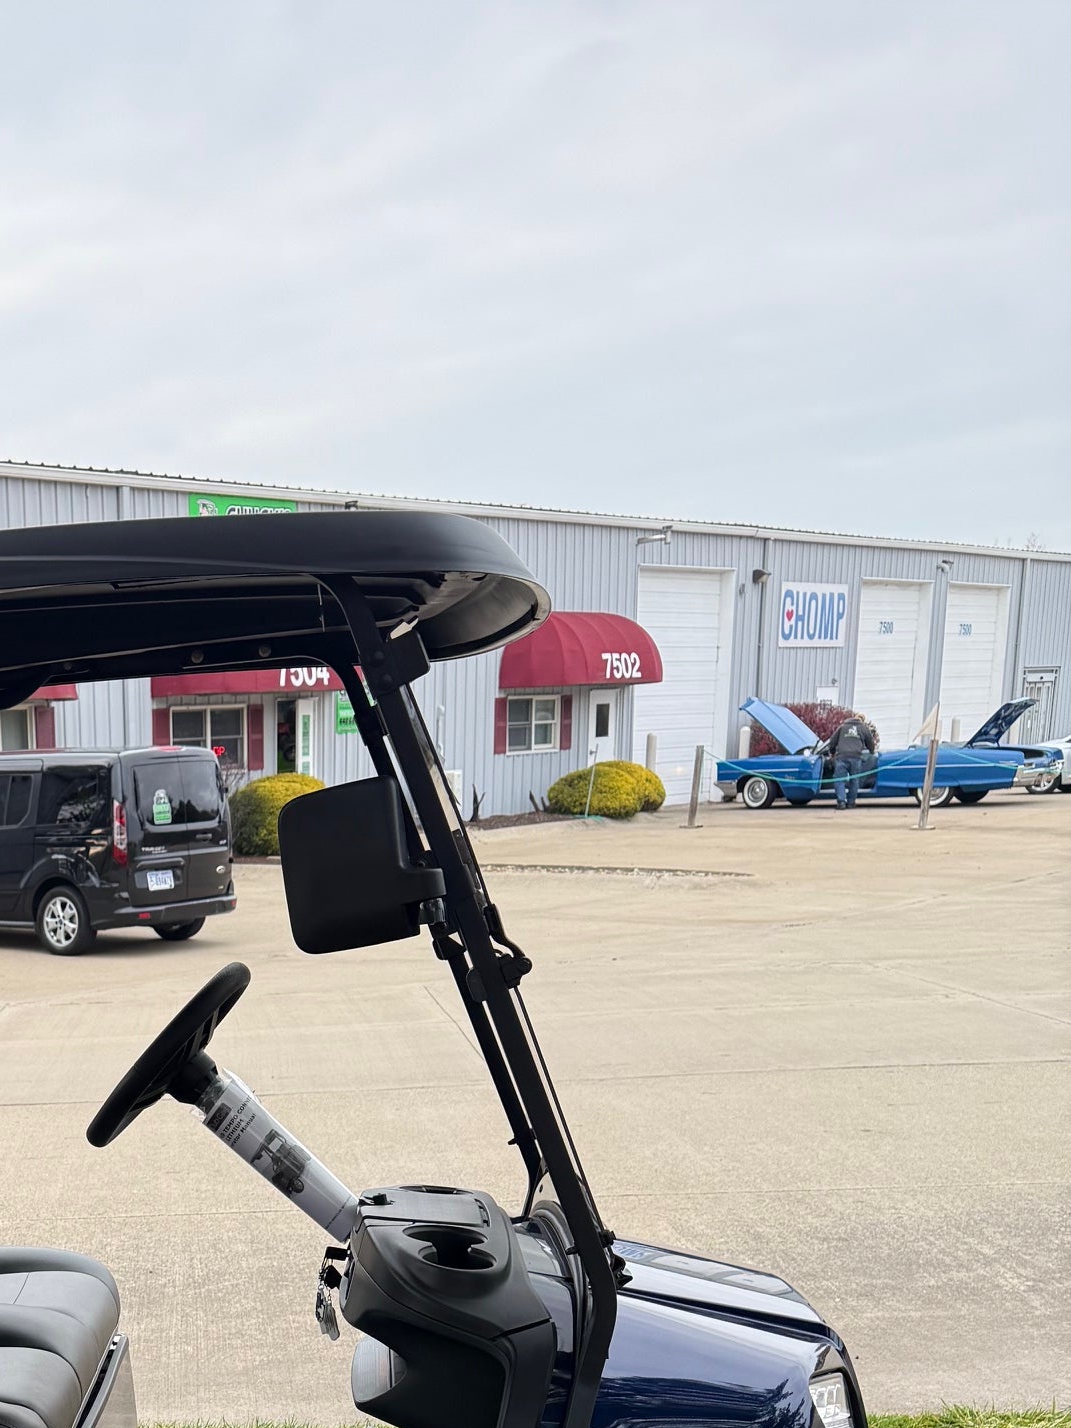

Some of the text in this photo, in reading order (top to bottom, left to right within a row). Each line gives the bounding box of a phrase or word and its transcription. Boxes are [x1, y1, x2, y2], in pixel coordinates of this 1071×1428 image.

[781, 589, 846, 641] CHOMP
[879, 621, 894, 634] 7500
[959, 623, 973, 636] 7500
[601, 651, 642, 679] 7502
